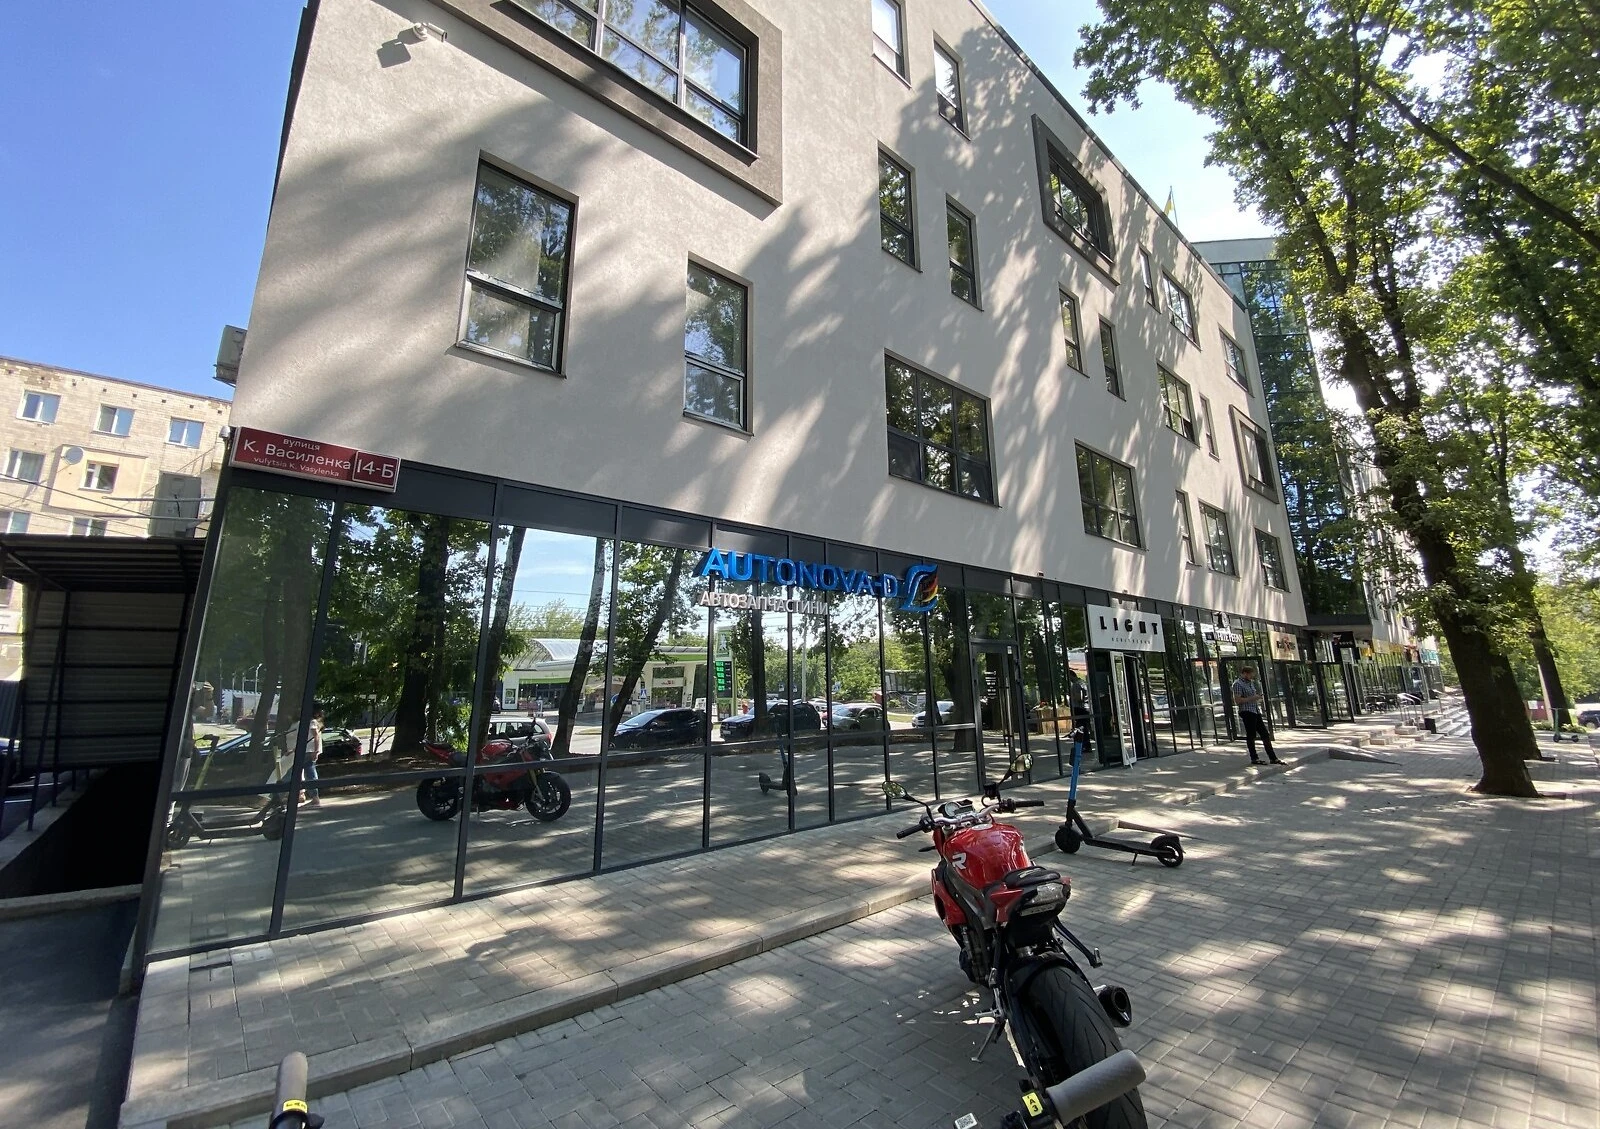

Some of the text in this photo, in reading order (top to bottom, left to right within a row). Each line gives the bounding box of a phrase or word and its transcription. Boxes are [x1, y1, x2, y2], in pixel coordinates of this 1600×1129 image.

[283, 438, 320, 451] вулиця
[265, 443, 352, 470] Василенка
[253, 457, 288, 468] vulytsia
[300, 464, 340, 477] Vasylenka
[356, 459, 394, 479] 14-Б
[697, 547, 898, 599] AUTONOVA-D
[699, 590, 829, 615] АВТОЗАПЧАСТИНИ
[1099, 616, 1158, 635] LIGHT
